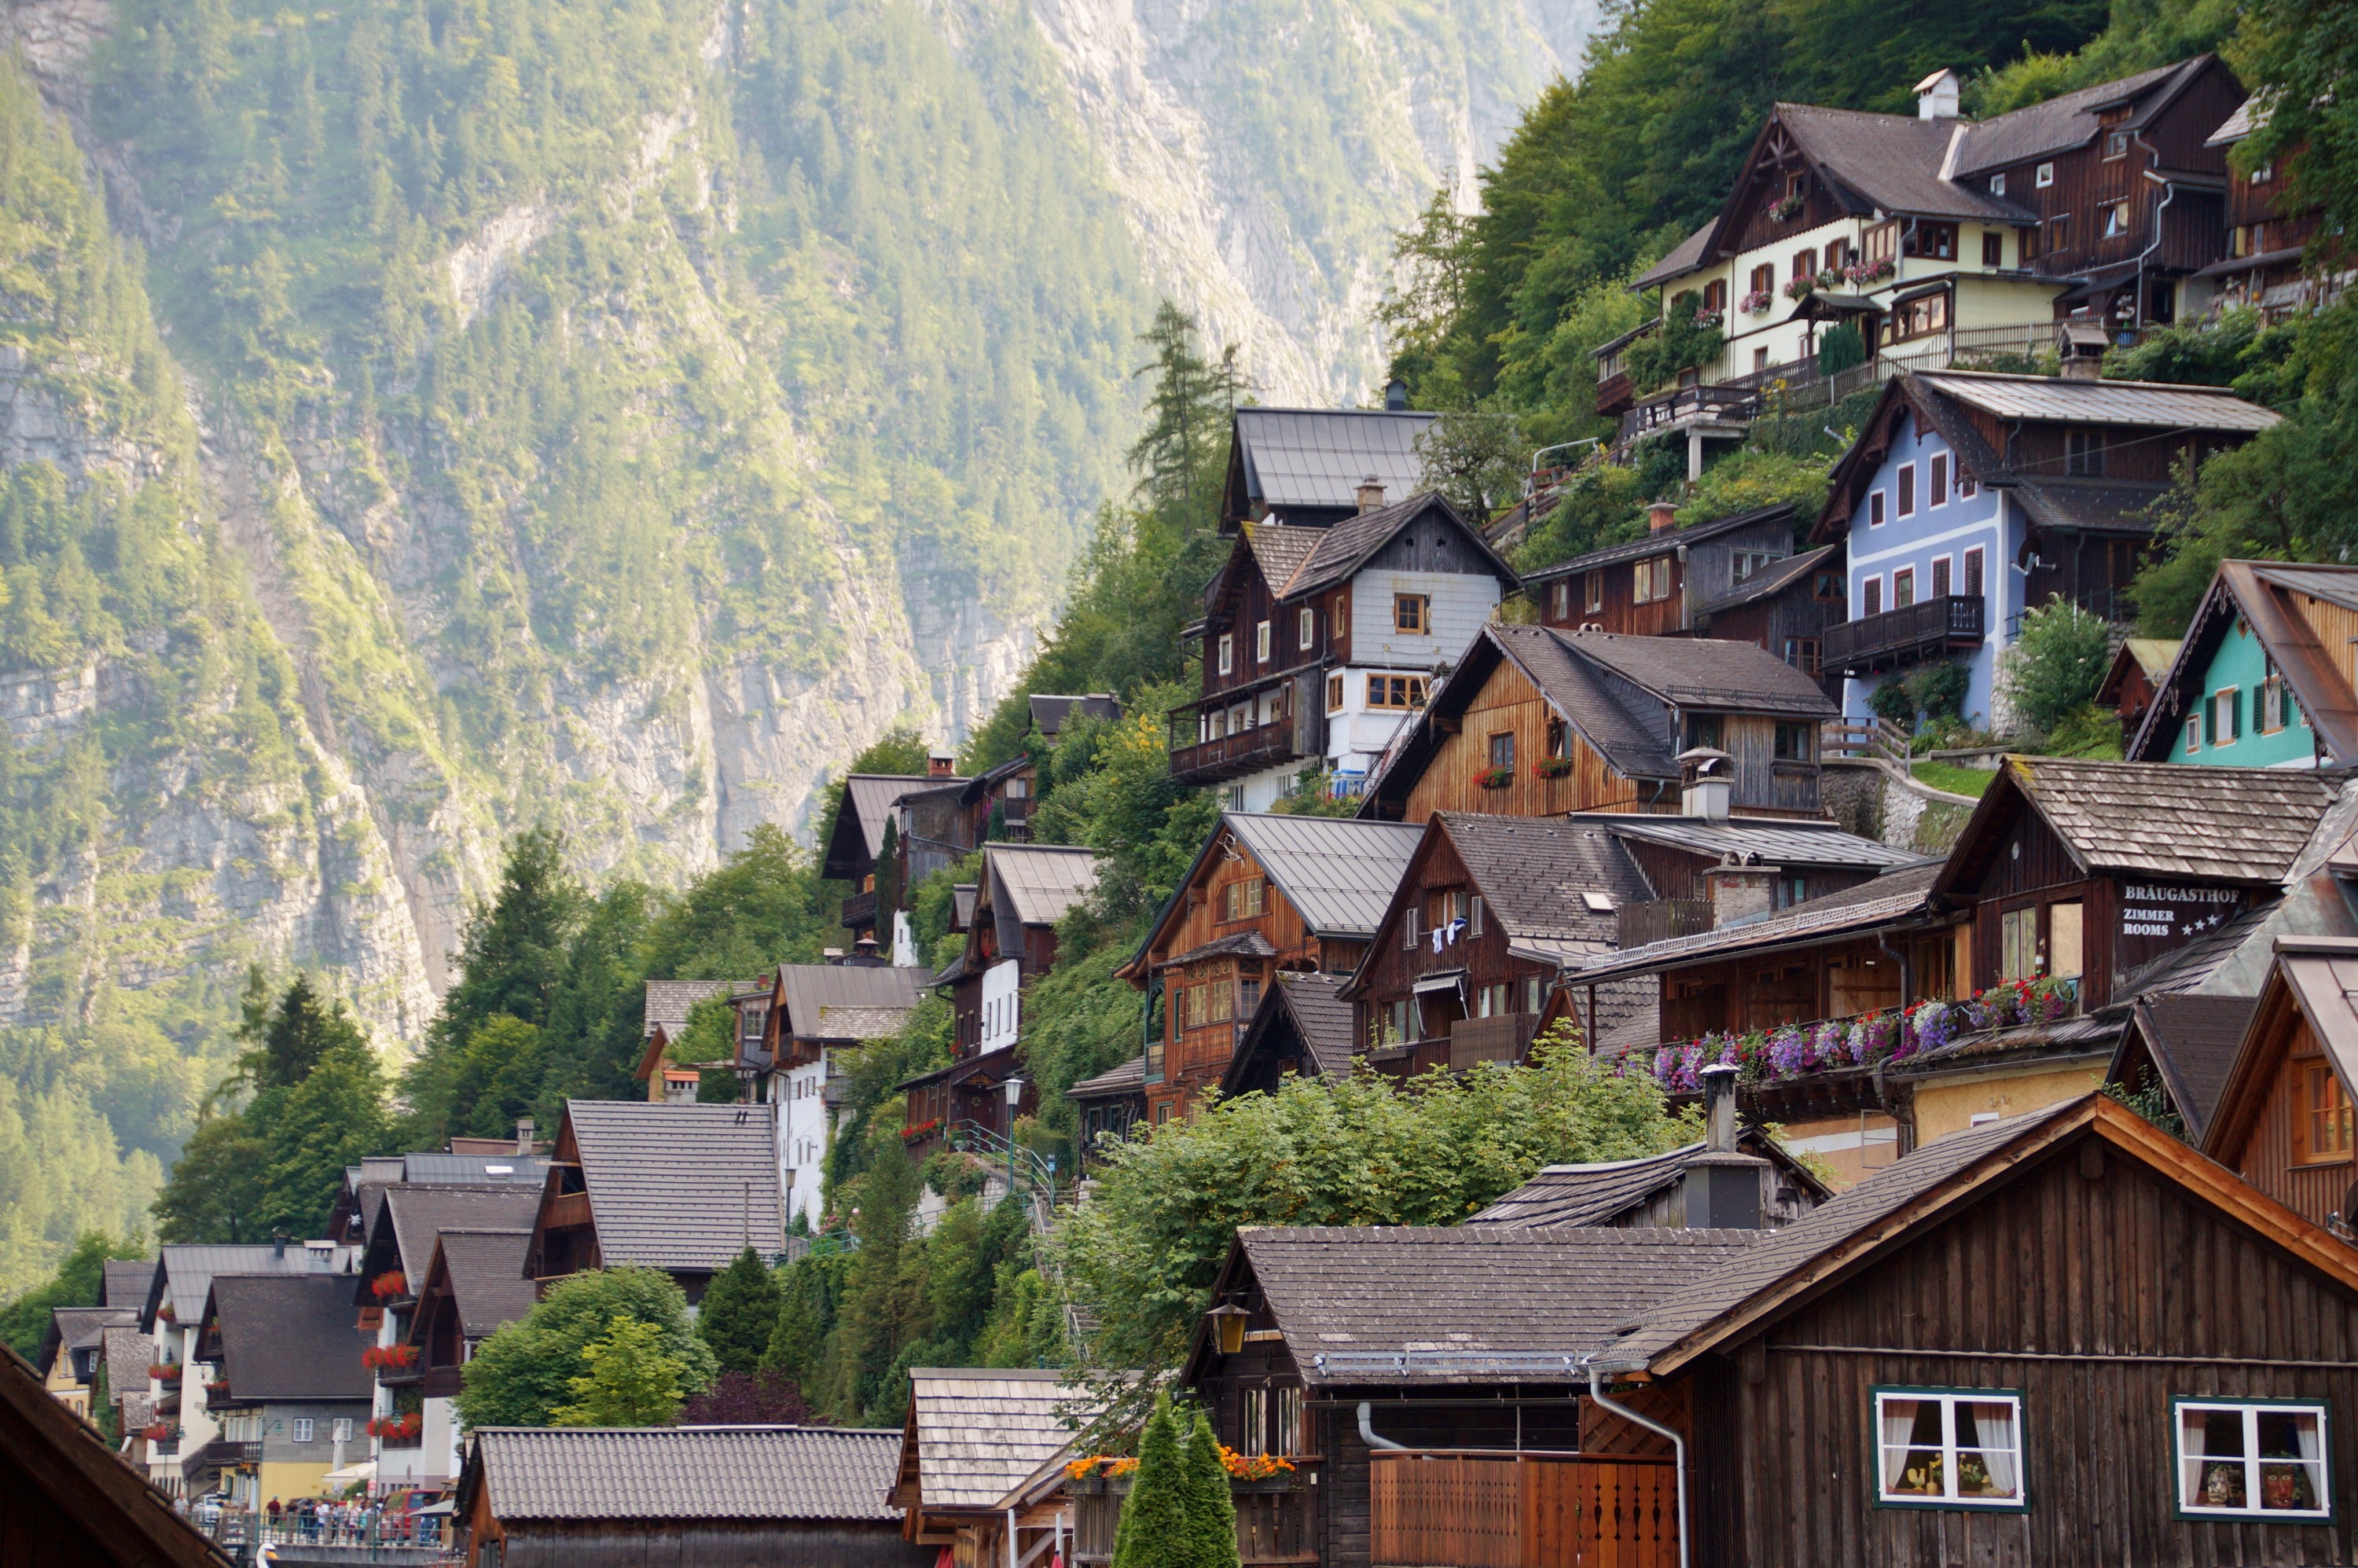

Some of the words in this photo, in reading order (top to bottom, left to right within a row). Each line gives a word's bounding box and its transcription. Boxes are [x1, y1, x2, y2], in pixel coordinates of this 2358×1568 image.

[2125, 884, 2239, 903] BRÄUGASTHOF
[2123, 908, 2175, 921] ZIMMER
[2123, 923, 2169, 936] ROOMS
